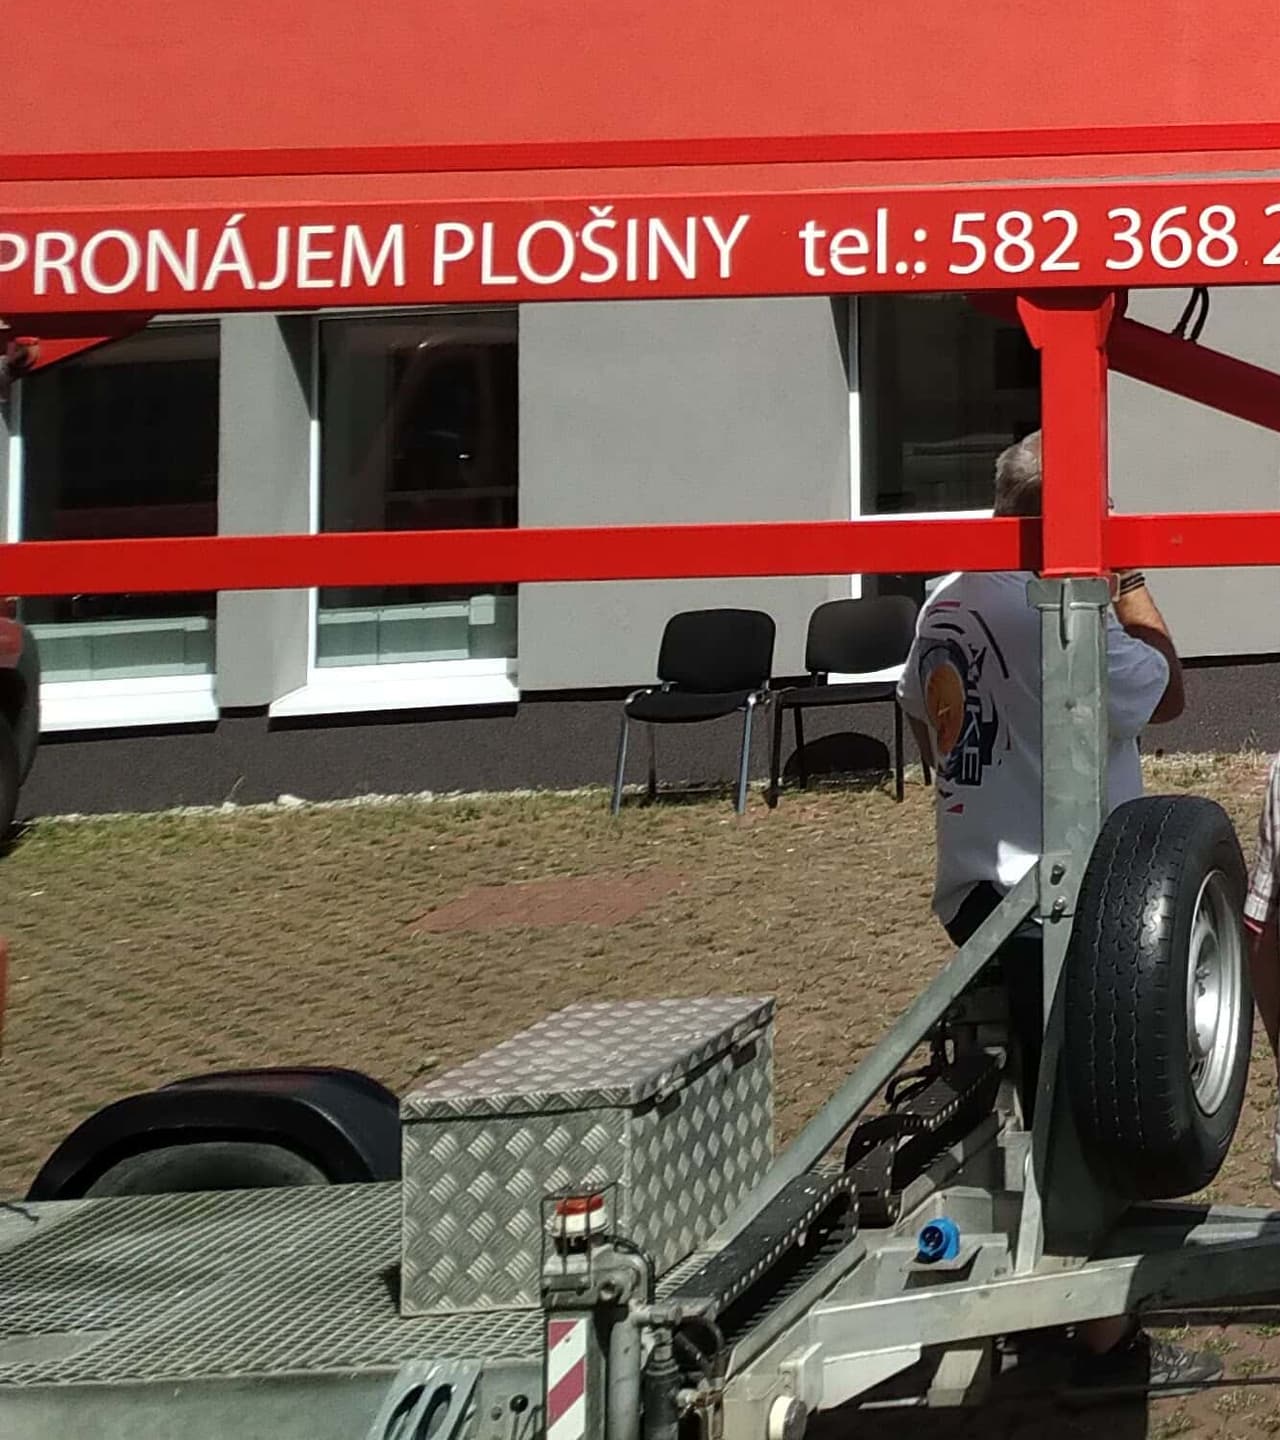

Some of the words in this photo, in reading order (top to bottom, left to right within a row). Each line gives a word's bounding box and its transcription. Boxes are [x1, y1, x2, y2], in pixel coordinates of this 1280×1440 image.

[0, 213, 407, 296] PRONÁJEM
[434, 205, 750, 287] PLOŠINY
[799, 208, 927, 277] tel.:
[949, 211, 1080, 275] 582
[1105, 205, 1239, 270] 368
